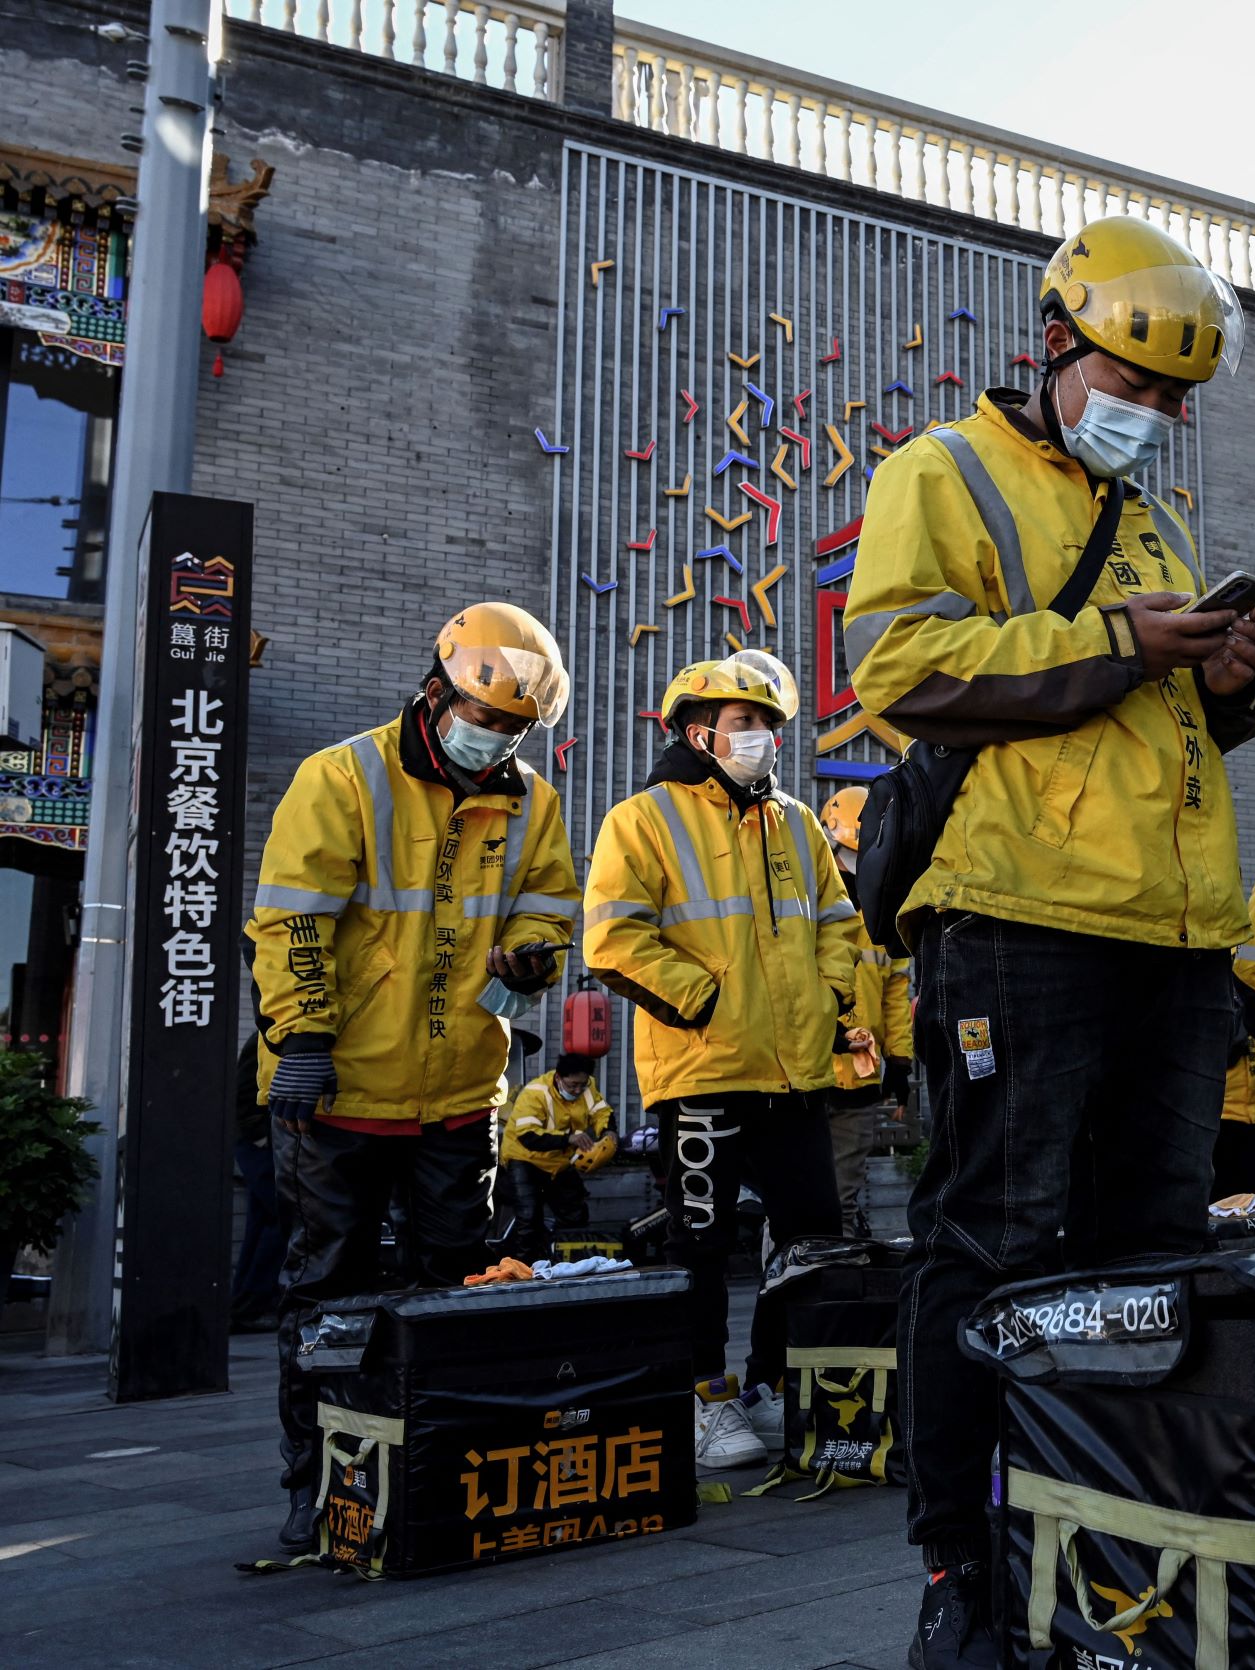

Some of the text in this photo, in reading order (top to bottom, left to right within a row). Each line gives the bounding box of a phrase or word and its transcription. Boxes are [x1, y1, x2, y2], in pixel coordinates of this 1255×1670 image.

[170, 622, 230, 649] 簋街
[170, 648, 226, 663] Guǐ Jie
[158, 688, 225, 1028] 北京餐饮特色街
[428, 817, 465, 1040] 美团外卖 买水果也快
[460, 1425, 664, 1521] 订酒店
[820, 1439, 873, 1459] 美团外卖
